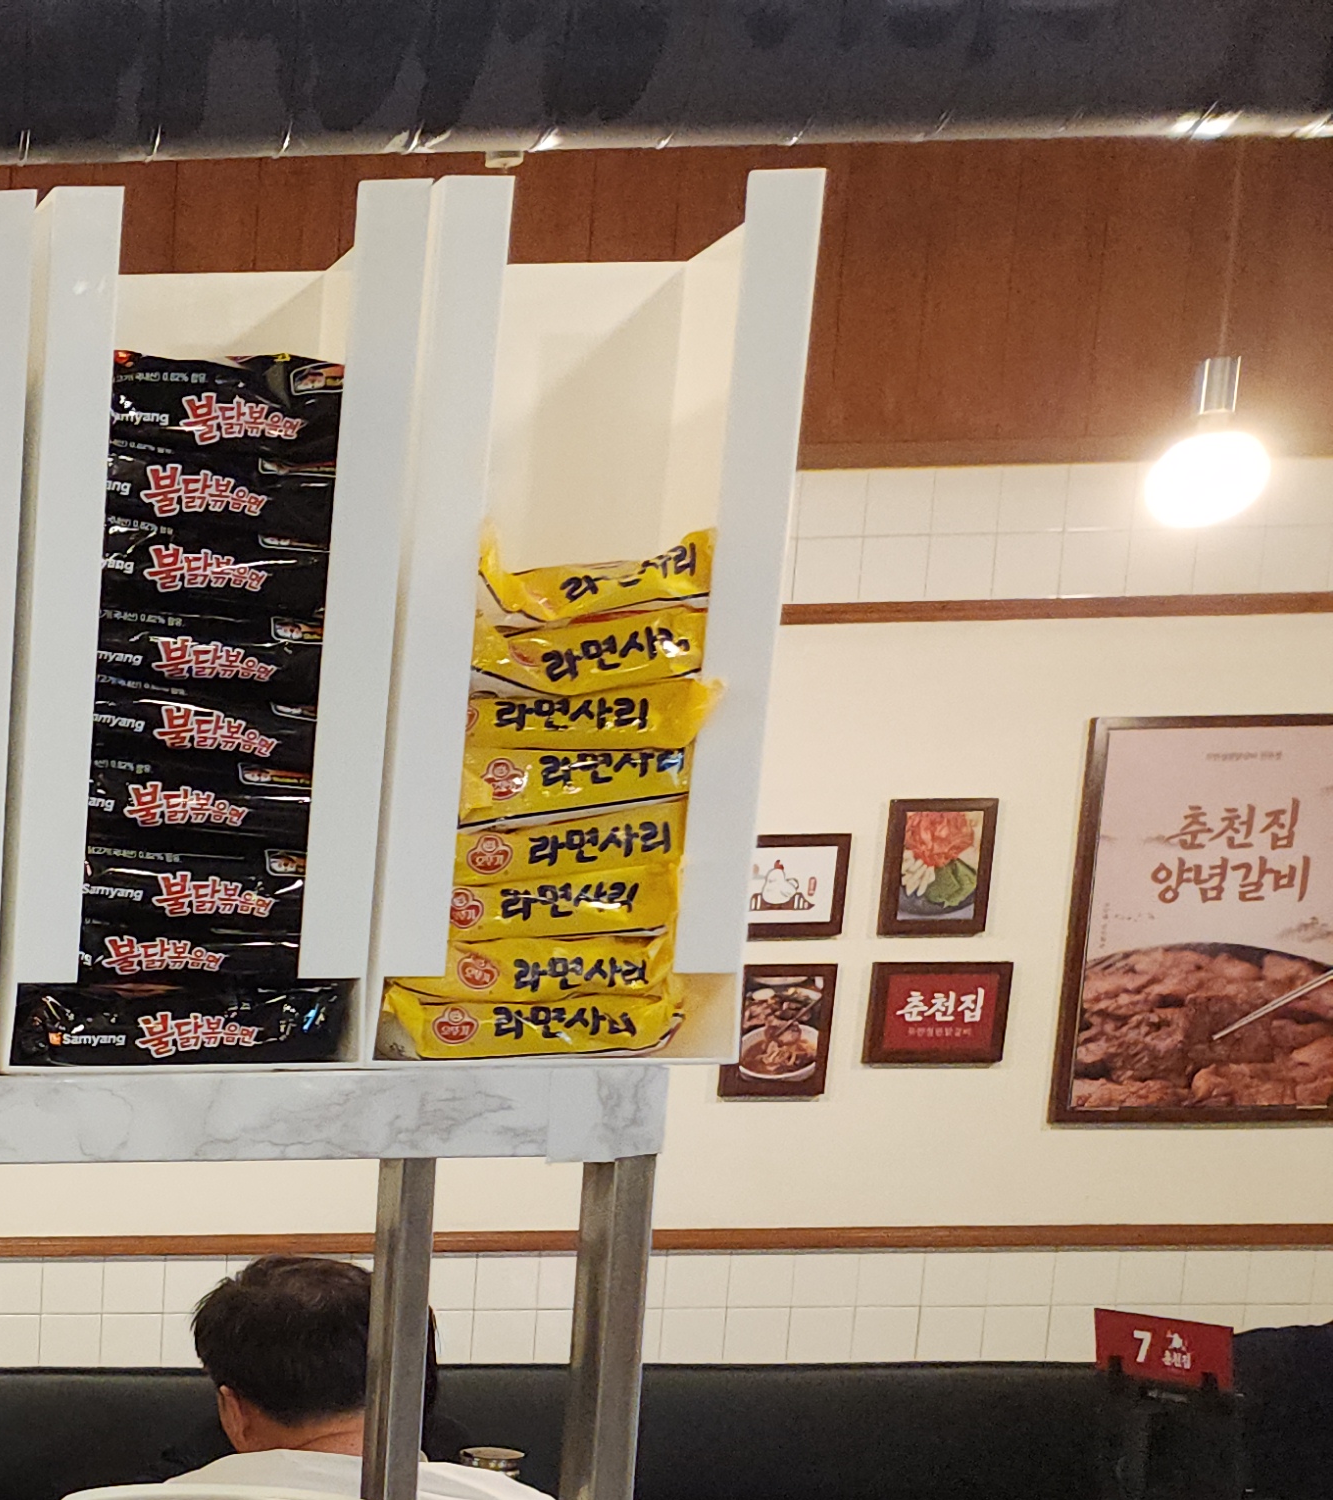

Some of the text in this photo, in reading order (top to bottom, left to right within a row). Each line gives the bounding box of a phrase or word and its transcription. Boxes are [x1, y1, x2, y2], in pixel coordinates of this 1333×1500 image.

[180, 392, 304, 445] 불닭볶음면
[141, 464, 267, 517] 불닭볶음면
[144, 545, 268, 592] 불닭볶음면
[152, 636, 275, 682] 불닭볶음면
[154, 705, 276, 757] 불닭볶음면
[494, 697, 649, 730] 라면사리
[124, 781, 248, 827] 불닭볶음면
[1165, 797, 1301, 850] 춘천집
[528, 820, 671, 867] 라면사리
[82, 882, 143, 901] Samyang
[152, 871, 276, 917] 불닭볶음면
[500, 881, 640, 921] 라면사리
[1151, 855, 1311, 903] 양념갈비
[102, 935, 225, 976] 불닭볶음면
[513, 956, 649, 992] 라면사리
[493, 1005, 637, 1040] 라면사리
[896, 988, 986, 1022] 춘천집
[62, 1032, 126, 1048] Samyang
[136, 1011, 260, 1058] 불닭볶음면
[1133, 1329, 1152, 1363] 7
